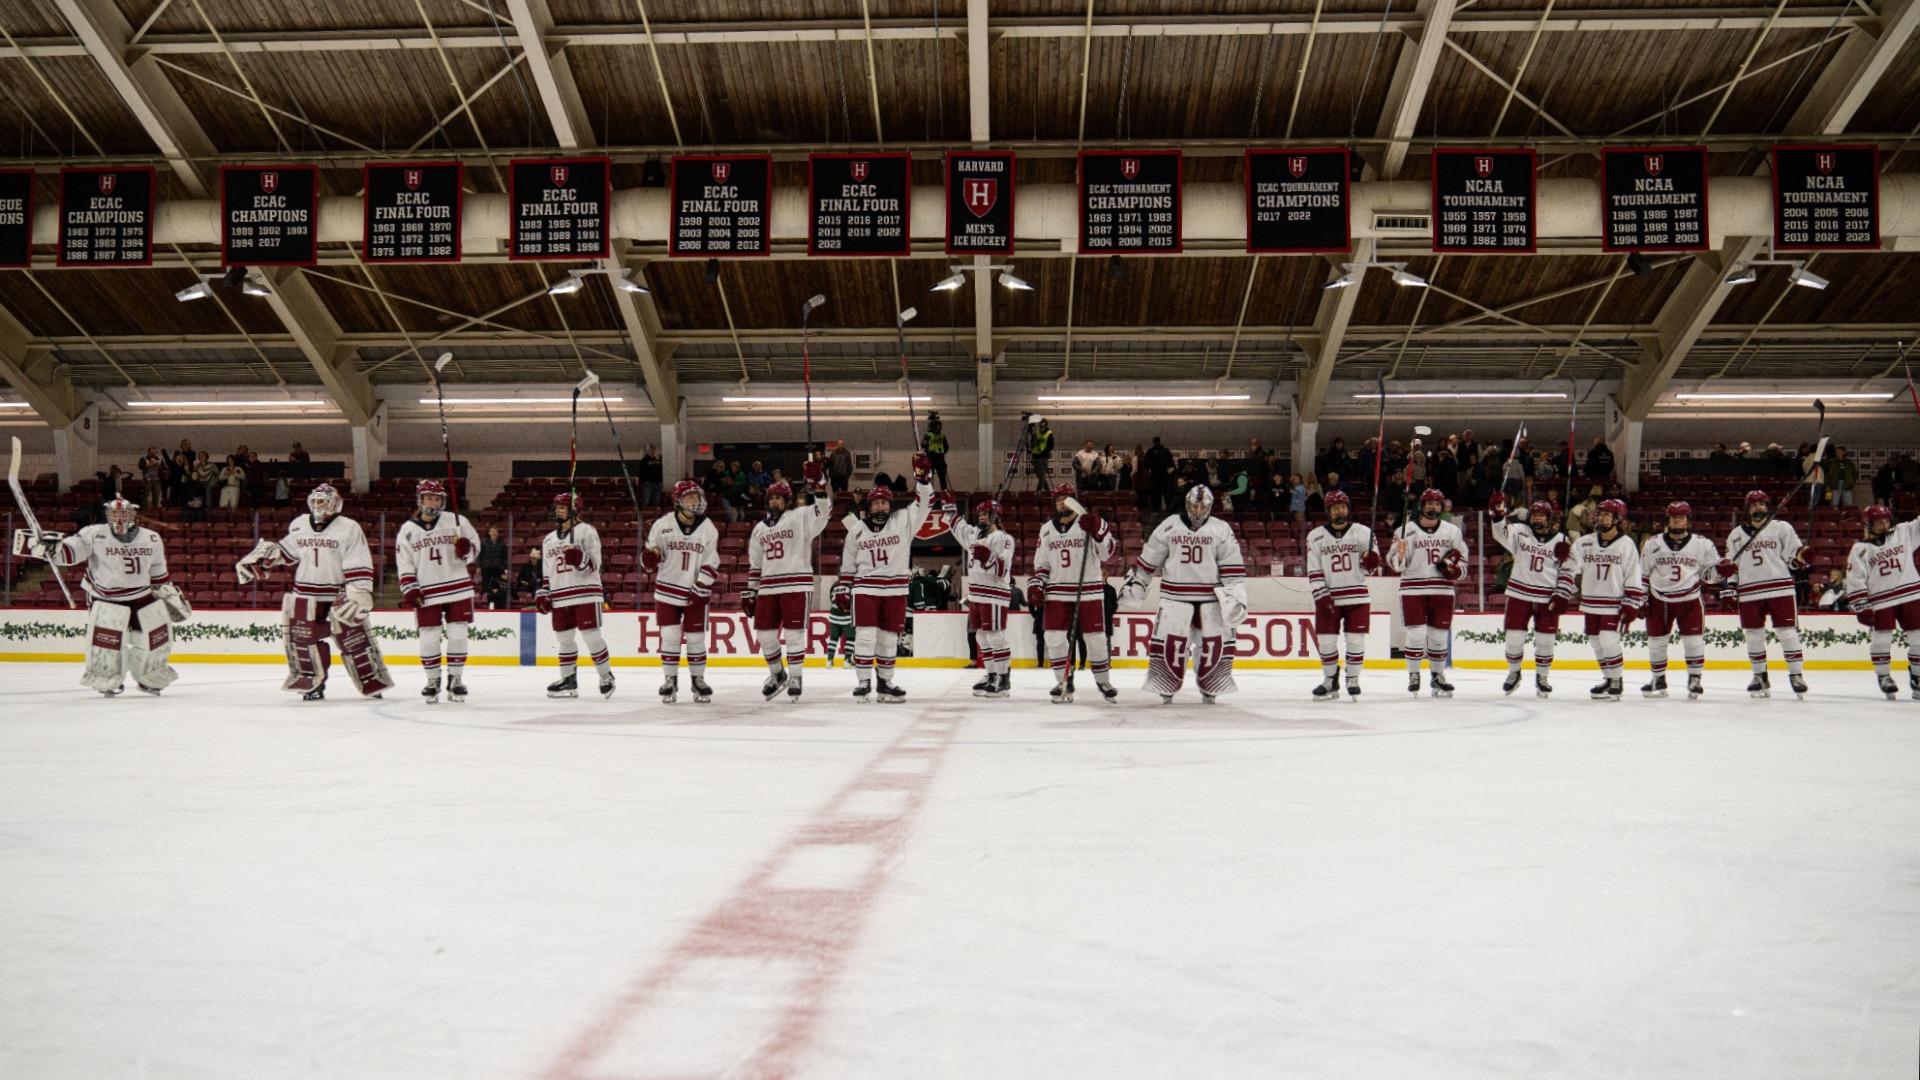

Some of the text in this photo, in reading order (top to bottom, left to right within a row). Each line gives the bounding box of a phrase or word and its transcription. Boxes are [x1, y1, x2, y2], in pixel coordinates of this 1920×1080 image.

[958, 161, 1003, 171] HARVARD
[1257, 183, 1339, 193] ECAC TOURNAMENT
[1465, 180, 1503, 192] NCAA
[1635, 179, 1674, 191] NCAA
[1806, 176, 1845, 189] NCAA
[543, 189, 577, 201] ECAC
[704, 186, 738, 198] ECAC
[842, 185, 876, 197] ECAC
[972, 183, 989, 206] H
[1089, 184, 1171, 194] ECAC TOURNAMENT
[90, 197, 123, 209] ECAC
[253, 196, 286, 208] ECAC
[396, 192, 430, 204] ECAC
[1089, 197, 1172, 209] CHAMPIONS
[1257, 195, 1340, 207] CHAMPIONS
[1443, 196, 1525, 206] TOURNAMENT
[1613, 193, 1696, 205] TOURNAMENT
[1784, 192, 1868, 203] TOURNAMENT
[522, 202, 598, 216] FINAL FOUR
[682, 200, 758, 212] FINAL FOUR
[820, 199, 899, 211] FINAL FOUR
[68, 211, 144, 224] CHAMPIONS
[232, 210, 307, 222] CHAMPIONS
[375, 206, 450, 219] FINAL FOUR
[1088, 213, 1172, 223] 1963 1971 1983
[1257, 212, 1311, 221] 2017 2022
[1443, 212, 1467, 221] 1955
[1473, 212, 1496, 221] 1957
[1612, 211, 1637, 220] 1985
[1674, 209, 1698, 218] 1987
[1784, 208, 1808, 217] 2004
[1814, 208, 1838, 217] 2005
[548, 220, 570, 228] 1985
[577, 219, 599, 228] 1987
[709, 217, 731, 226] 2001
[738, 217, 760, 226] 2002
[818, 216, 900, 225] 2015 2016 2017
[1784, 221, 1869, 230] 2015 2016 2017
[122, 228, 143, 236] 1975
[258, 227, 281, 235] 1992
[430, 223, 451, 231] 1970
[679, 229, 759, 237] 2003 2004 2005
[818, 228, 900, 237] 2018 2019 2022
[1088, 225, 1172, 234] 1987 1994 2002
[1473, 224, 1496, 233] 1971
[1503, 225, 1526, 233] 1974
[232, 238, 281, 248] 1994 2017
[373, 234, 451, 244] 1971 1972 1974
[954, 236, 1006, 246] ICE HOCKEY
[1088, 237, 1172, 246] 2004 2006 2015
[1443, 236, 1526, 245] 1975 1982 1983
[1614, 234, 1699, 245] 1994 2002 2003
[1815, 233, 1839, 242] 2022
[1846, 233, 1870, 242] 2023
[737, 241, 759, 249] 2012
[818, 240, 841, 249] 2023
[67, 252, 88, 260] 1986
[94, 251, 115, 259] 1987
[372, 248, 394, 256] 1975
[84, 417, 90, 430] 8
[150, 534, 158, 543] C
[297, 538, 339, 549] HARVARD
[1171, 535, 1213, 545] HARVARD
[105, 547, 153, 556] HARVARD
[667, 541, 705, 554] HARVARD
[765, 540, 784, 560] 28
[1519, 542, 1554, 559] HARVAR
[313, 548, 319, 567] 1
[429, 547, 442, 565] 4
[869, 548, 889, 568] 14
[1060, 549, 1071, 568] 9
[1180, 545, 1202, 564] 30
[1425, 548, 1440, 565] 16
[1584, 554, 1622, 564] HARVARD
[1752, 549, 1763, 566] 5
[123, 557, 141, 574] 31
[681, 551, 690, 571] 11
[1331, 553, 1352, 572] 20
[1529, 554, 1545, 572] 10
[1655, 556, 1697, 568] HARVARD
[1877, 557, 1903, 577] 24
[1596, 563, 1611, 581] 17
[1669, 565, 1681, 582] 3
